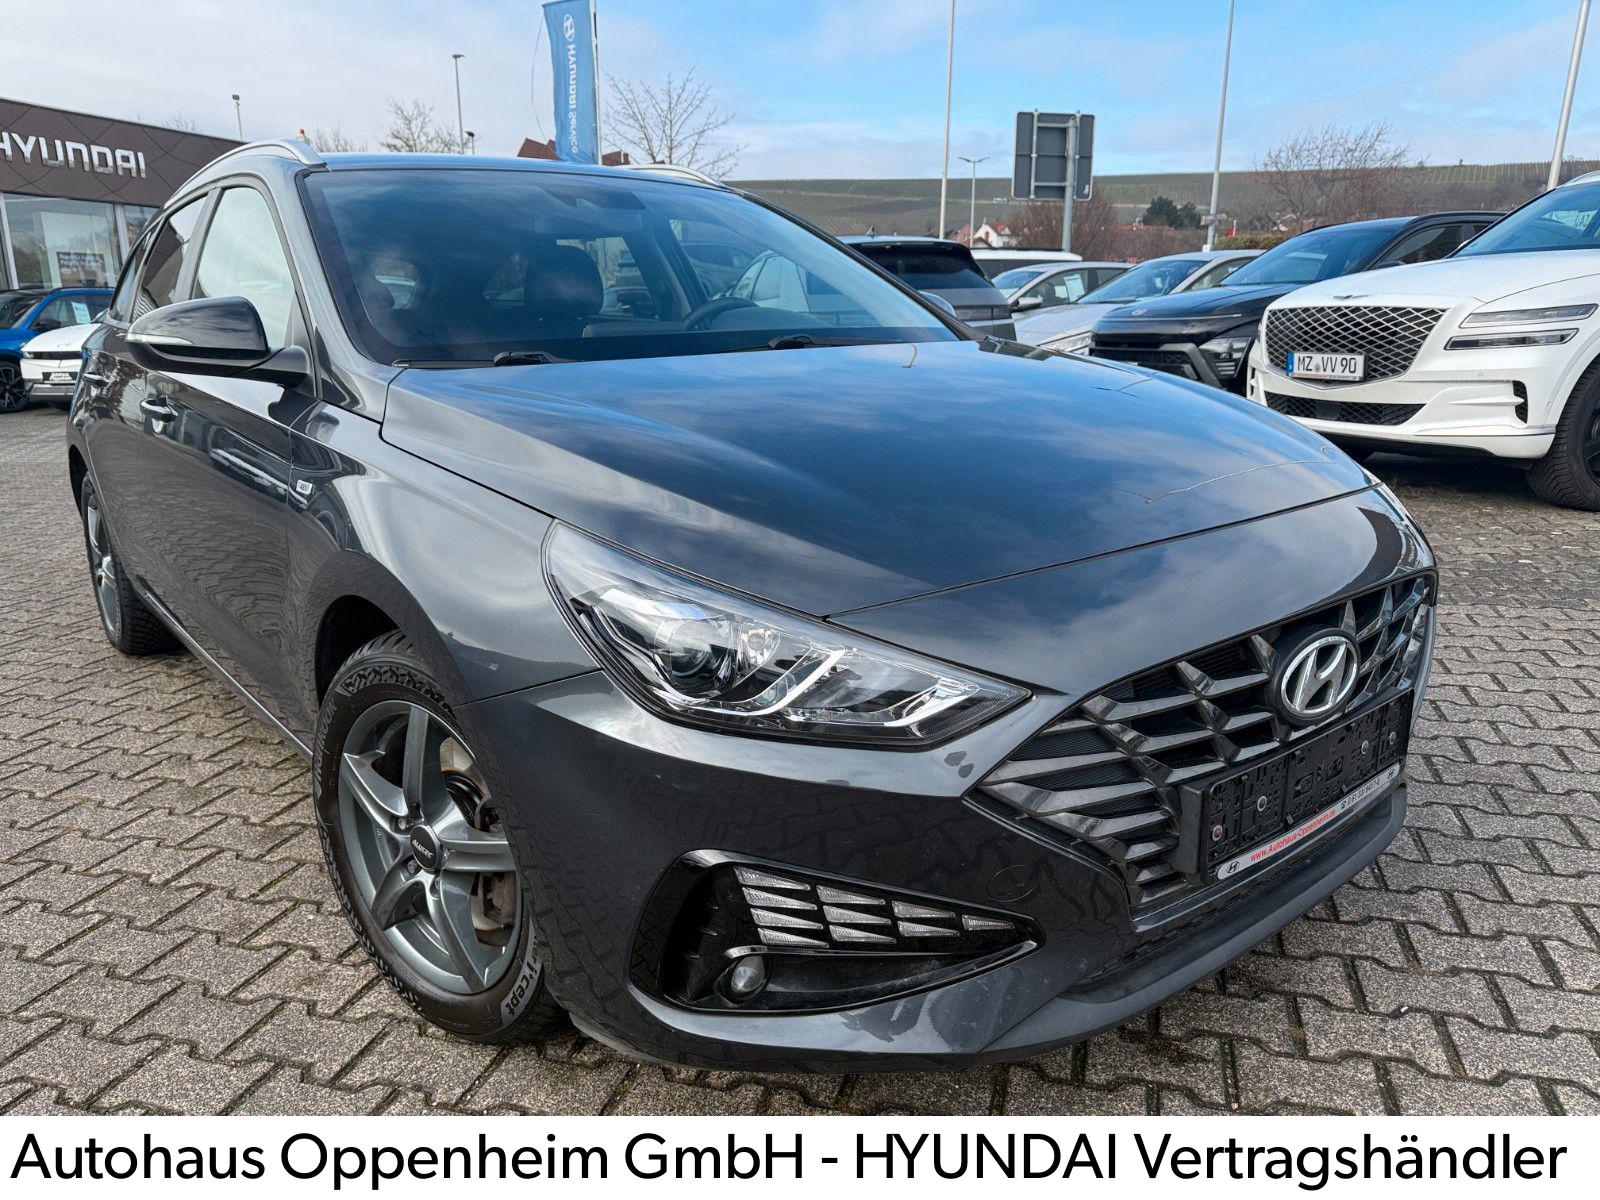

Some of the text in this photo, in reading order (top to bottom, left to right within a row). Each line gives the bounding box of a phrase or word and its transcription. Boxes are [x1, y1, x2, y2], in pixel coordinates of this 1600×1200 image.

[1297, 356, 1357, 374] MZ VV 90
